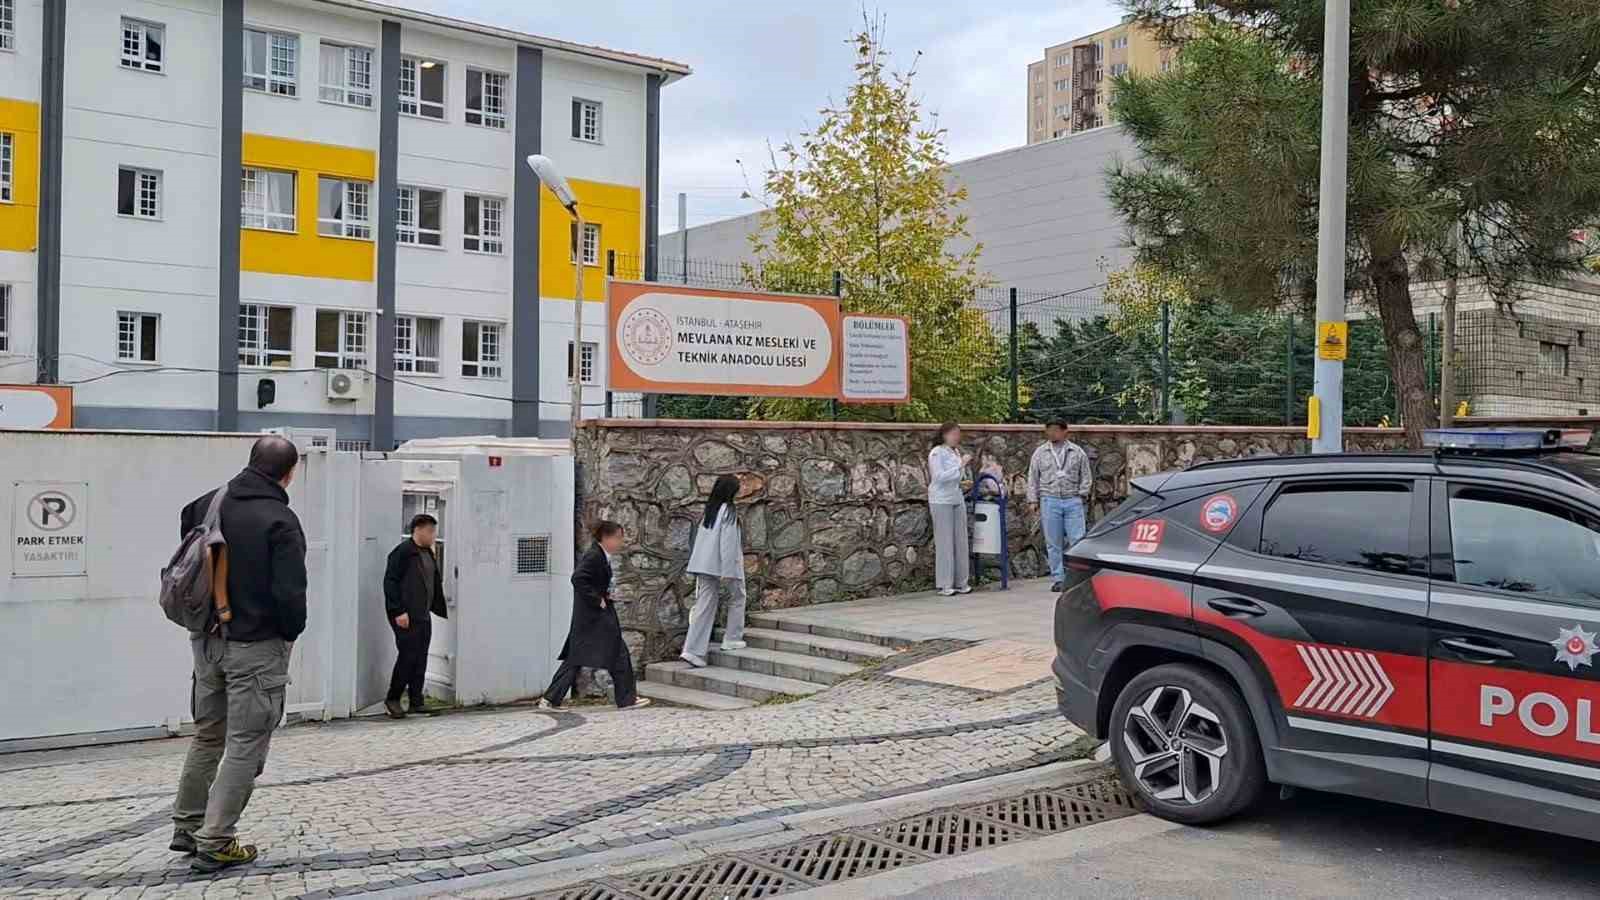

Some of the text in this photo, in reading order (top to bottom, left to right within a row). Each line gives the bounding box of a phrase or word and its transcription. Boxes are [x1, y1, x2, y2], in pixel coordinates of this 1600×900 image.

[677, 332, 816, 350] MEVLANA KIZ MESLEKİ VE
[677, 350, 807, 368] TEKNİK ANADOLU LİSESİ
[17, 535, 84, 546] PARK ETMEK
[1135, 523, 1160, 541] 112
[1480, 684, 1600, 744] POL
